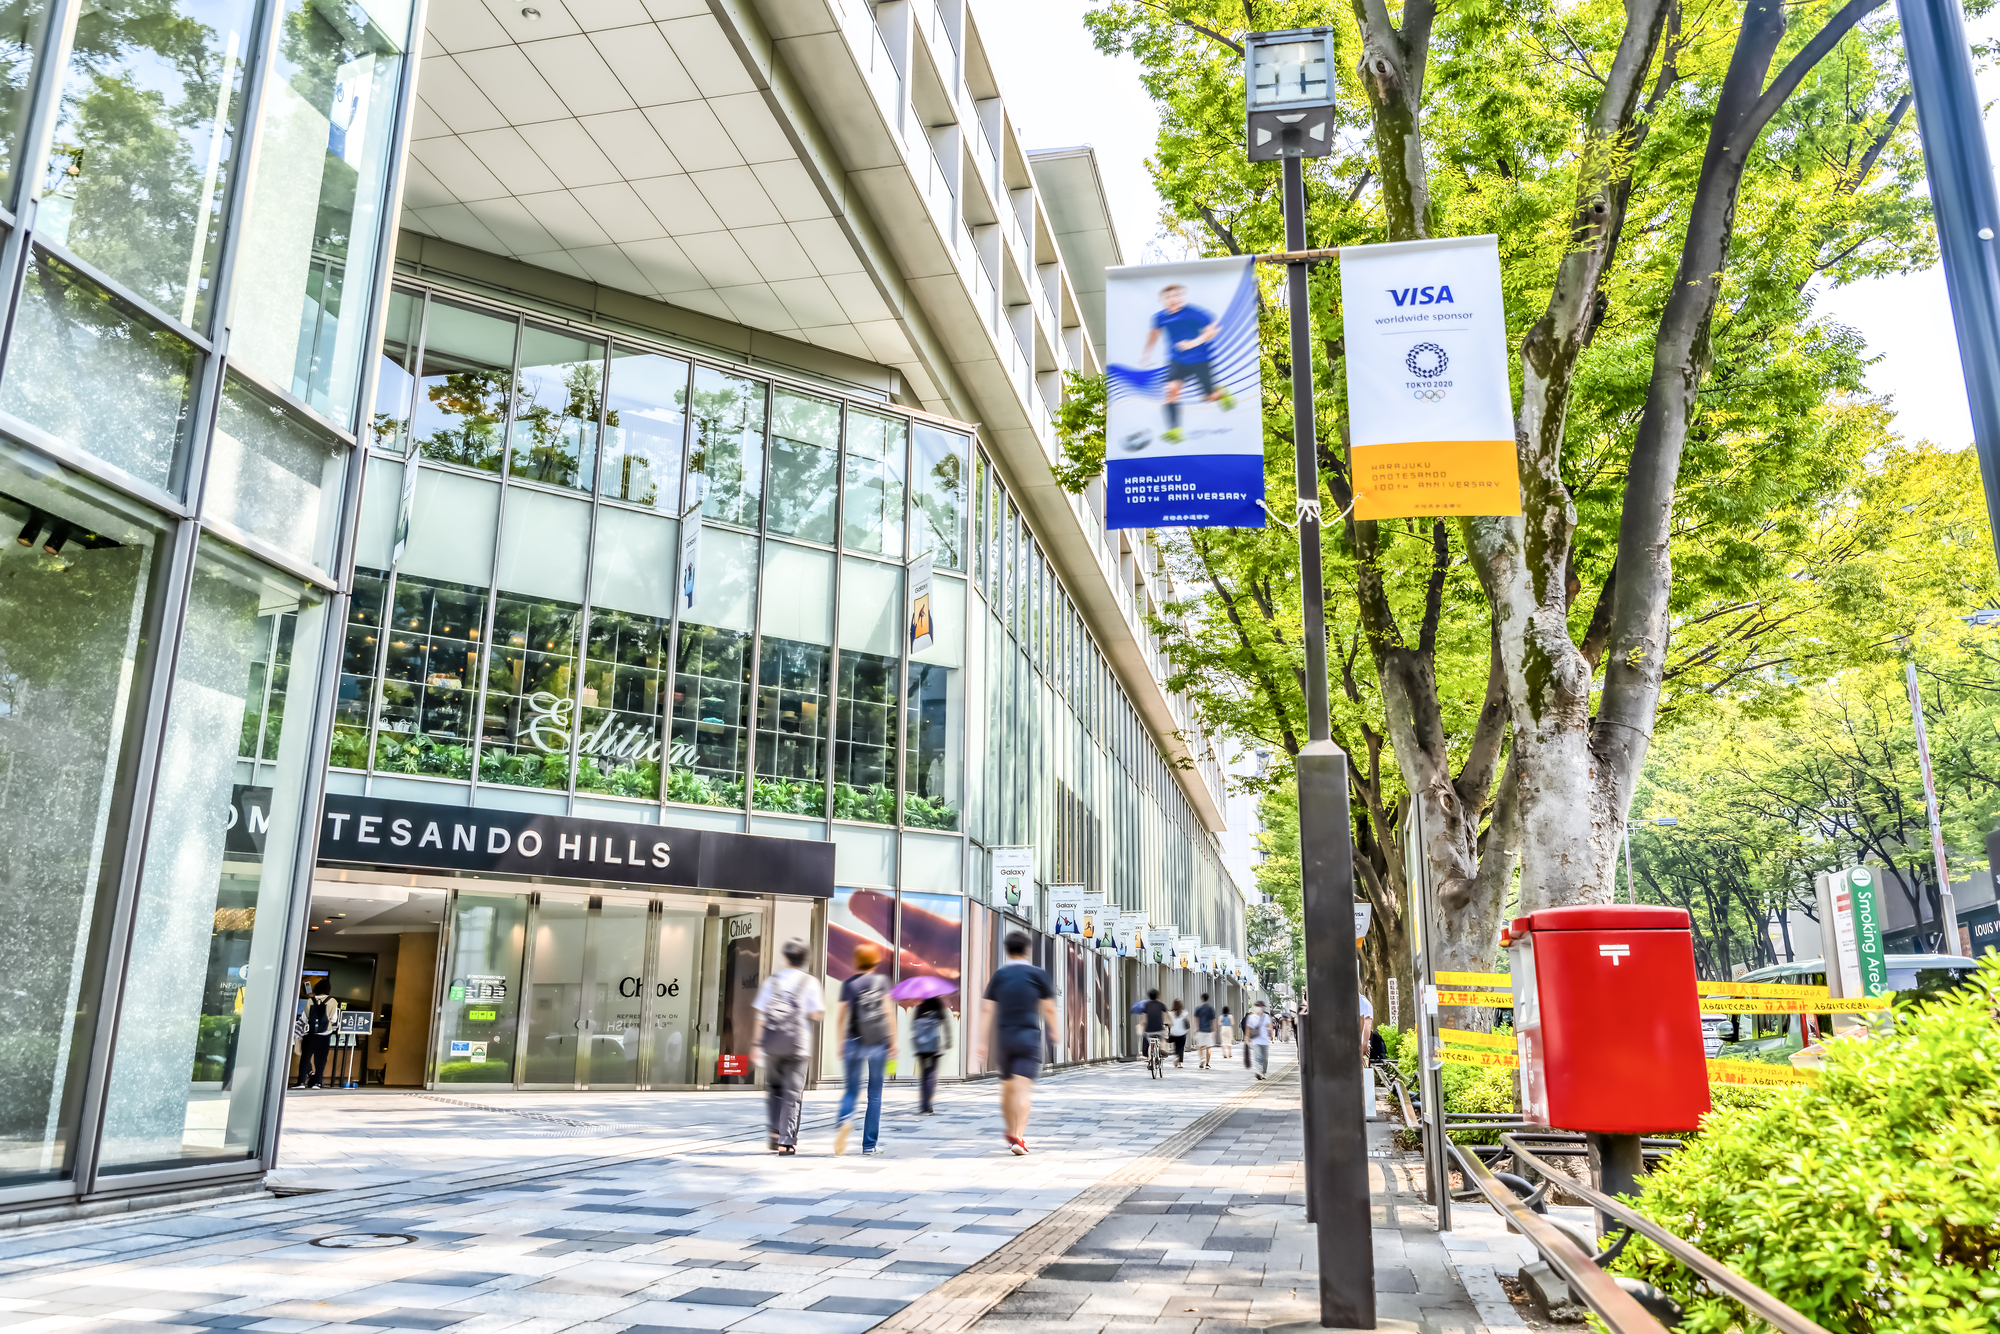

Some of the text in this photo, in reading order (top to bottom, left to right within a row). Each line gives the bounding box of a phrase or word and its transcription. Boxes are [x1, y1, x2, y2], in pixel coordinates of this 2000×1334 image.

[1385, 285, 1454, 307] VISA
[1375, 312, 1473, 325] worldwide sponsor
[1405, 380, 1453, 389] TOKYO 2020
[1371, 462, 1431, 470] HARAJUKU
[1125, 474, 1182, 484] HARAJUKU
[1372, 471, 1447, 481] OMOTESANDO
[1125, 483, 1196, 494] OMOTESANDO
[1374, 483, 1409, 491] 100TH
[1127, 492, 1247, 504] 100TH ANNIVERSARY
[558, 833, 671, 868] HILLS
[1000, 869, 1025, 877] Galaxy
[730, 919, 752, 937] Chloé
[1975, 921, 1993, 937] LOUIS
[1858, 891, 1880, 993] Smoking Area
[619, 976, 679, 998] Choé
[1438, 992, 1479, 1004] 立入禁止
[1703, 1001, 1869, 1012] 入らないでください 立入禁止 入らないでください
